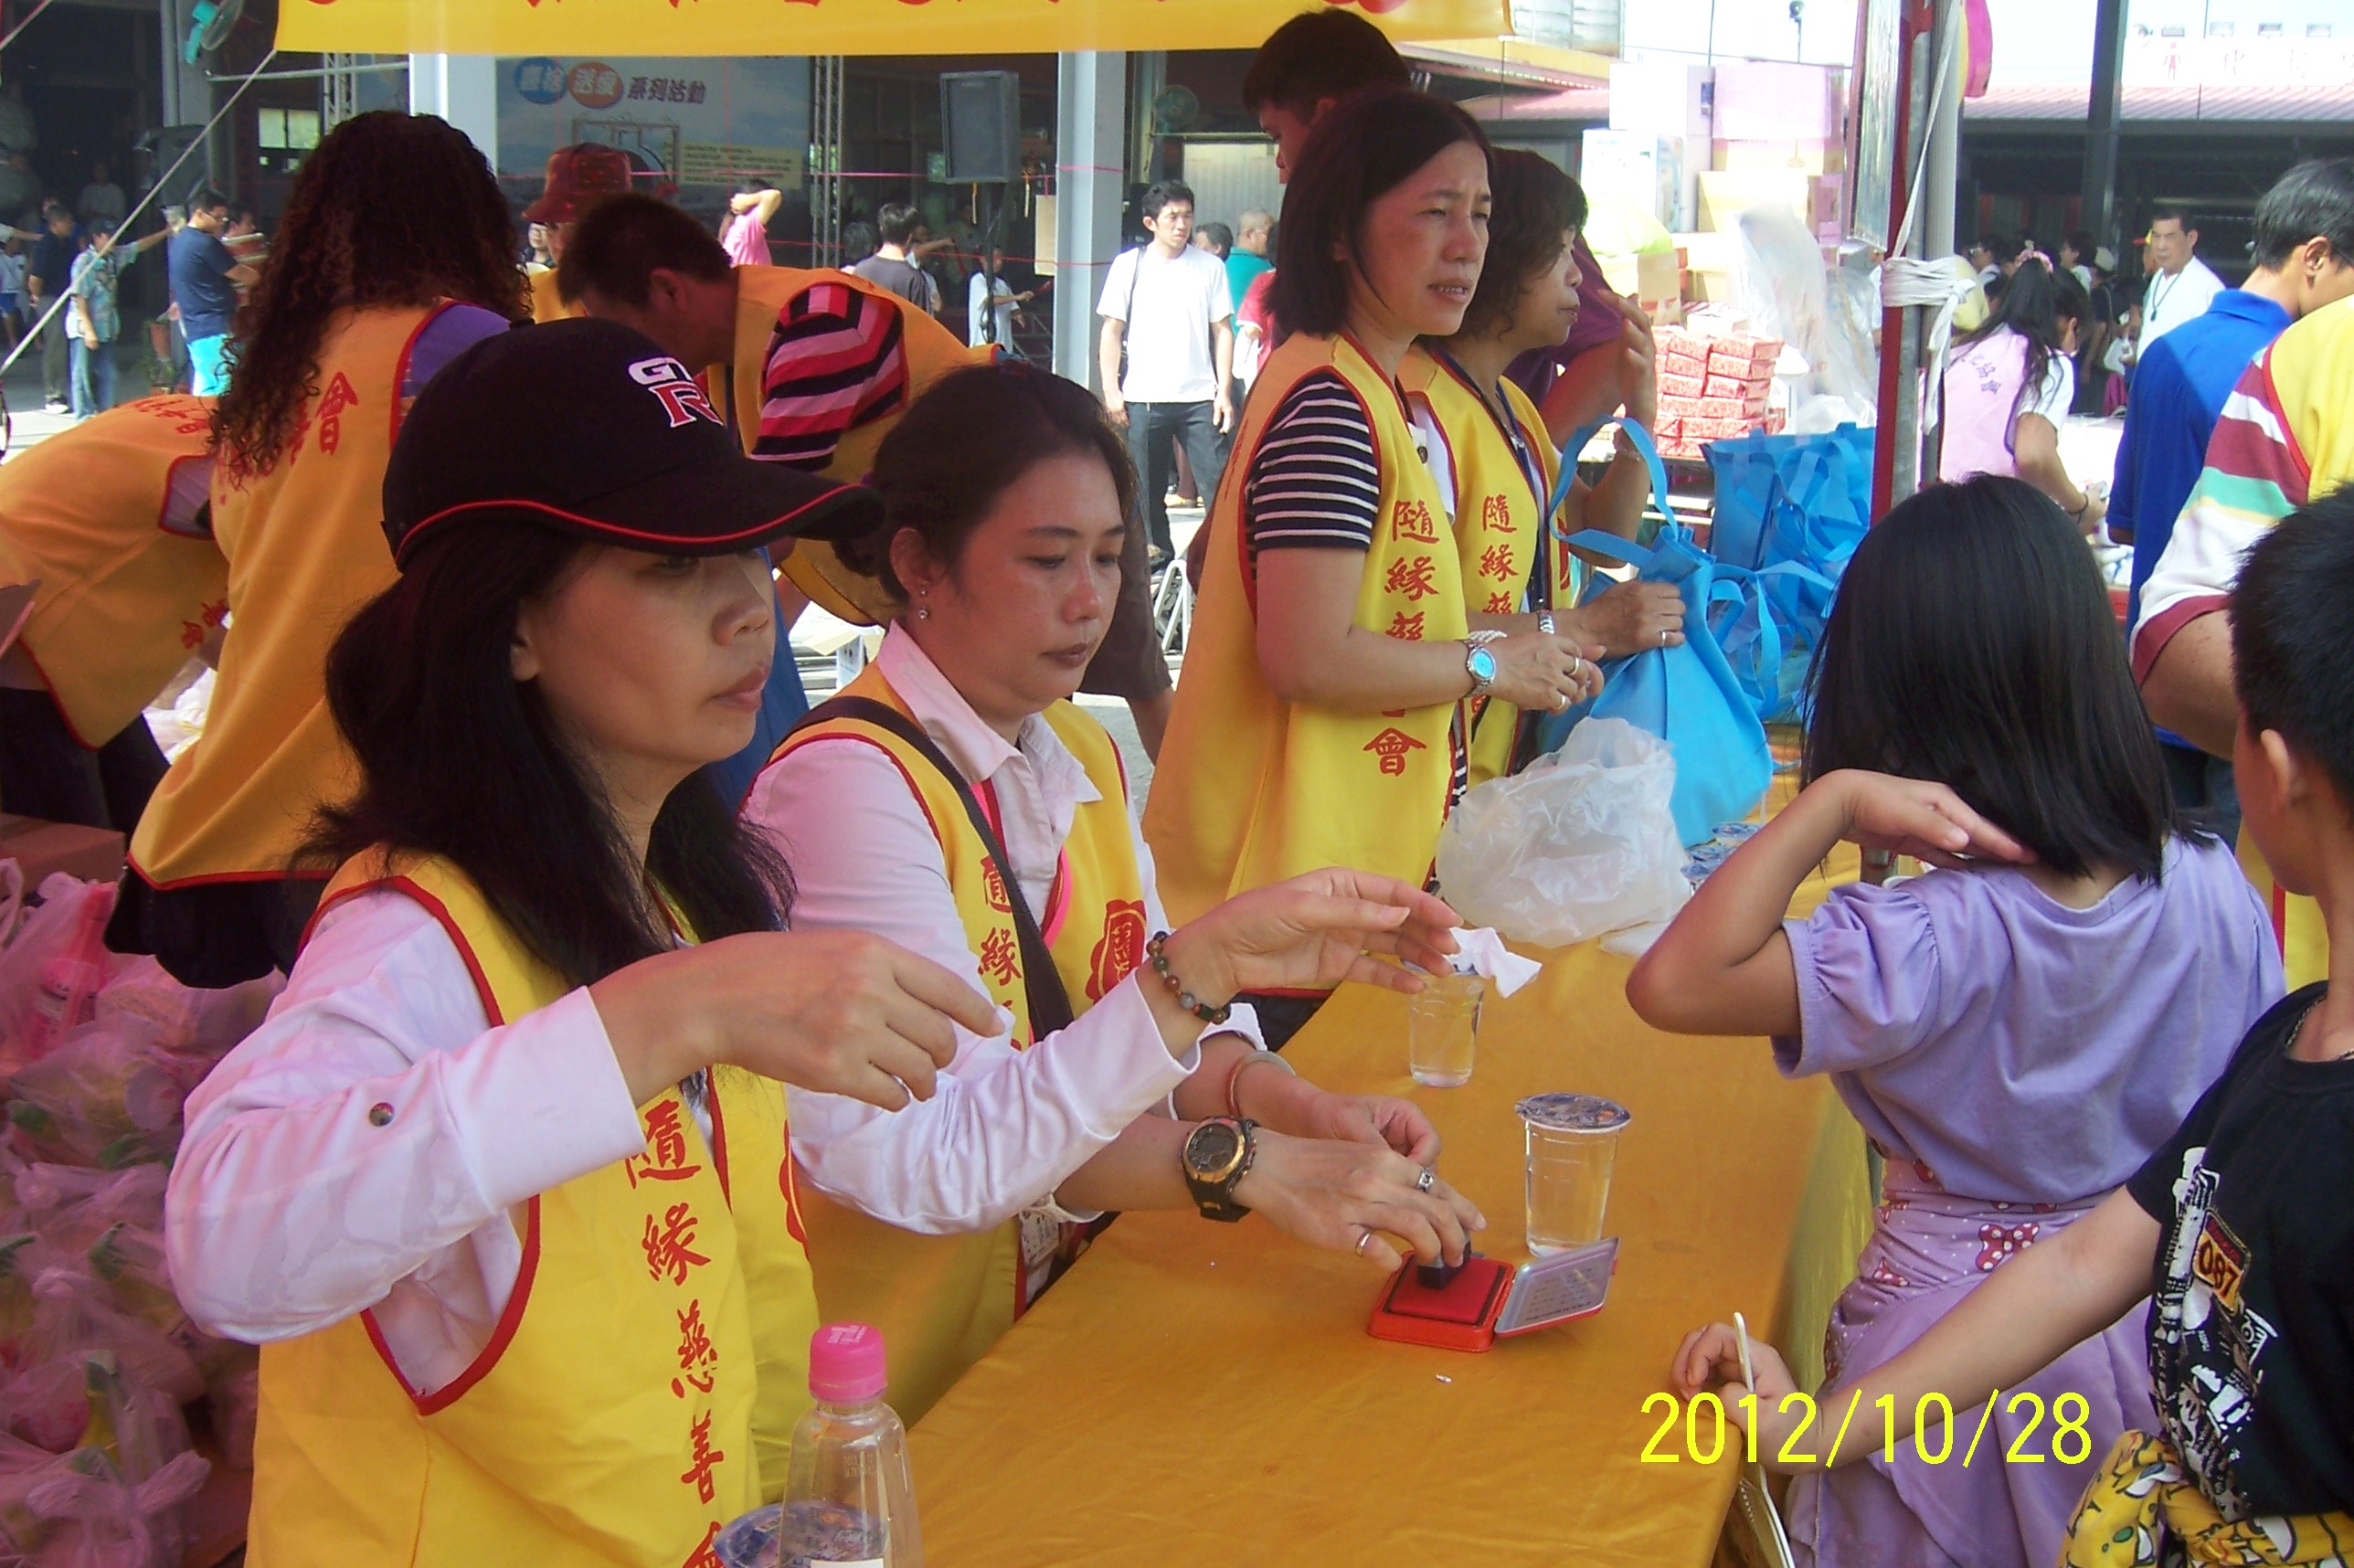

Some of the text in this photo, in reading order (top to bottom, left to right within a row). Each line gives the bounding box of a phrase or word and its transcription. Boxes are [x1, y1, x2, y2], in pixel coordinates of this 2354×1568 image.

[627, 76, 706, 104] 系列活動
[1363, 499, 1440, 777] 隨緣慈會
